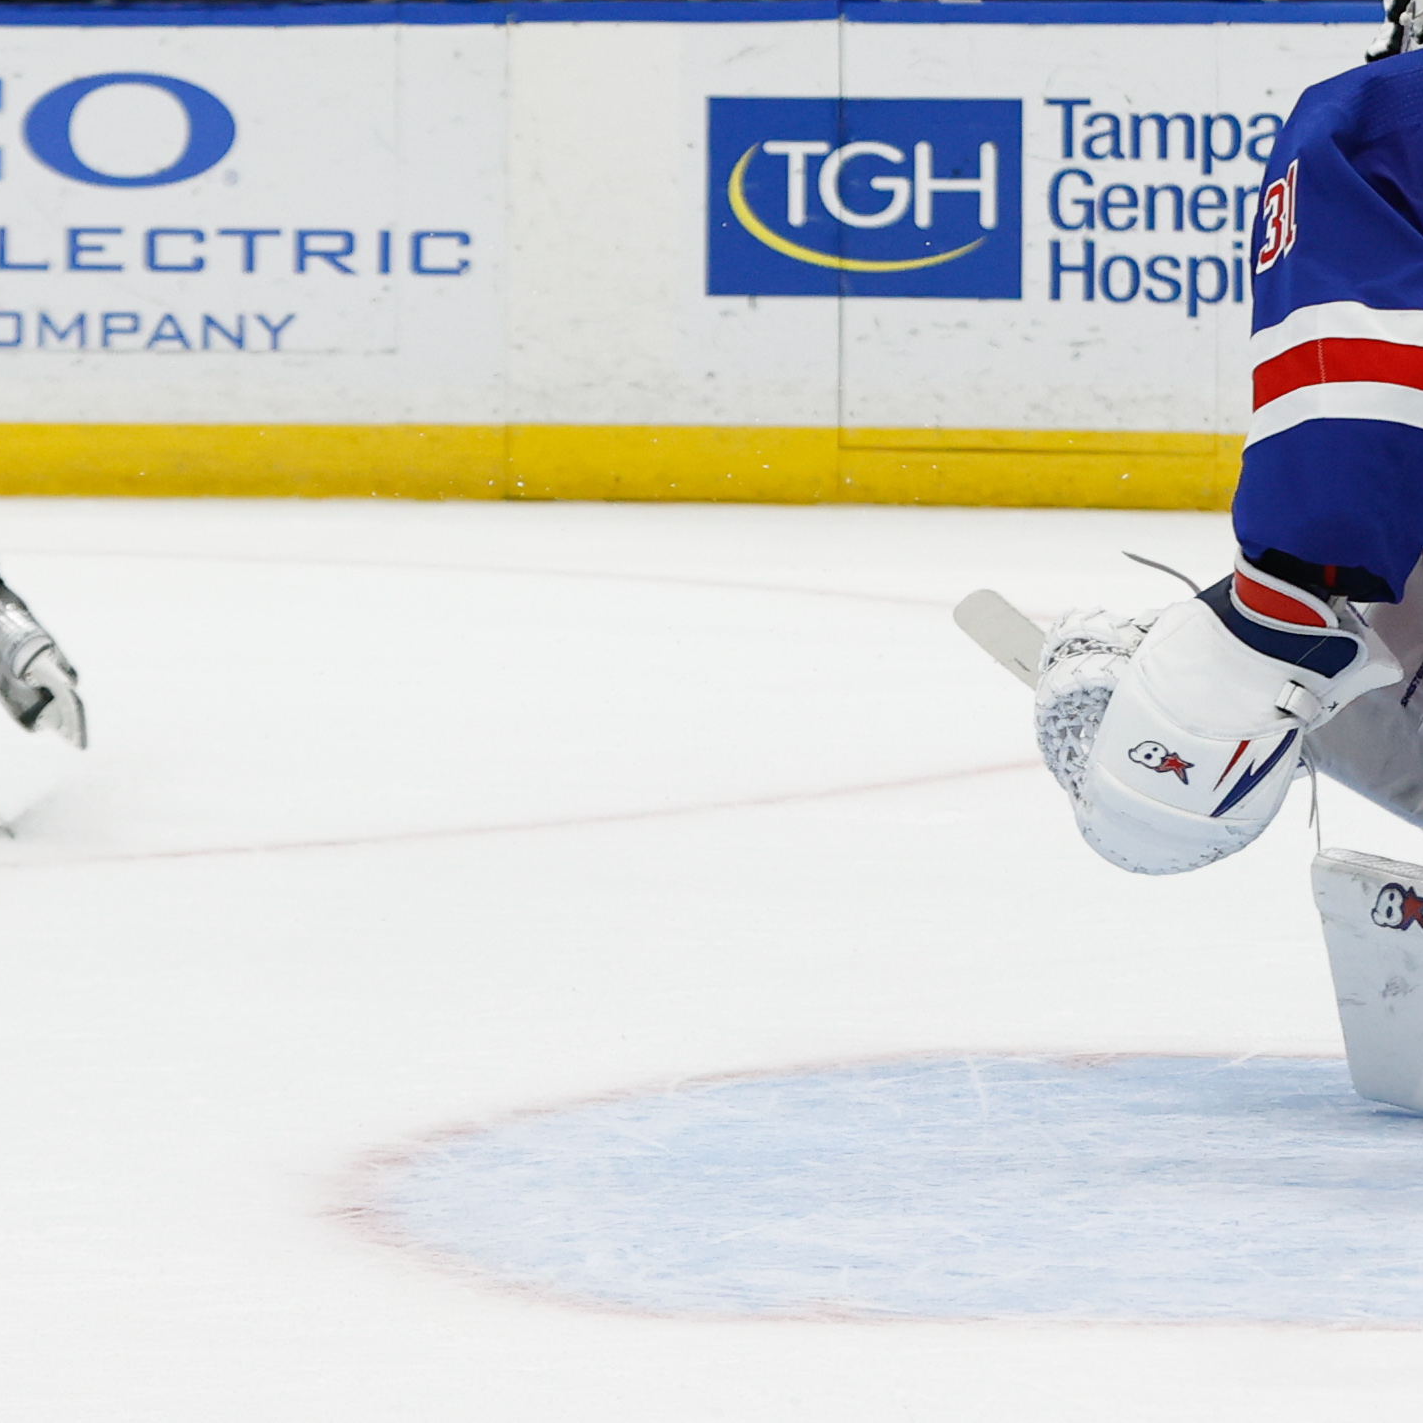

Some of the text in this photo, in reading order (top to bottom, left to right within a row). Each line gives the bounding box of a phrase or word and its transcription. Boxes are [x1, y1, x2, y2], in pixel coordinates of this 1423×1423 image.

[762, 139, 999, 230] TGH
[1047, 167, 1261, 234] Gener
[1256, 159, 1299, 274] 31
[1047, 239, 1245, 318] Hospi
